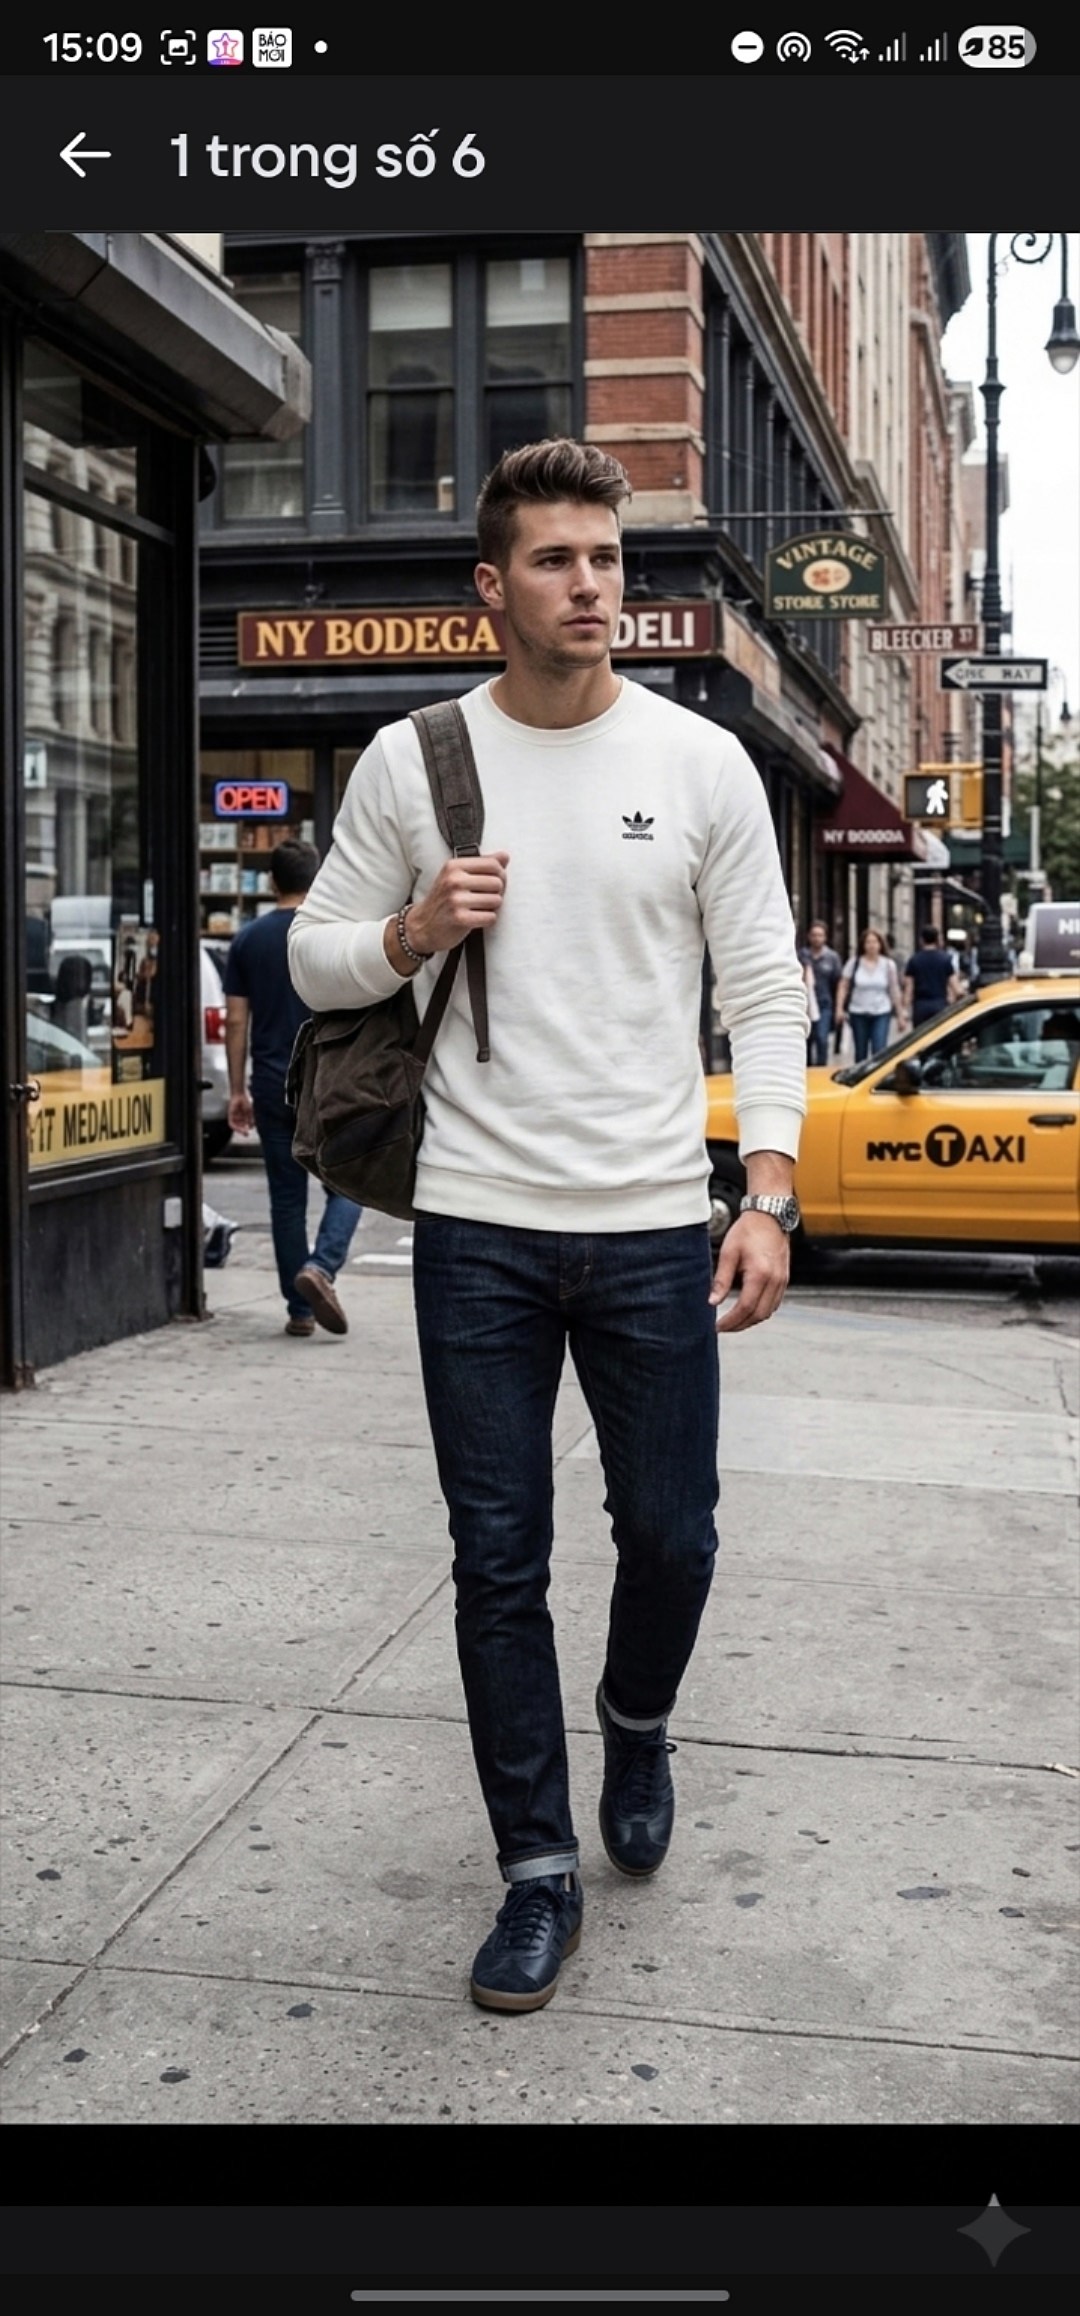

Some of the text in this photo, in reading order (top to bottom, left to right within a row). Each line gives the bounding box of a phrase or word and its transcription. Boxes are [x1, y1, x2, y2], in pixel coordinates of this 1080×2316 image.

[776, 538, 878, 571] VINTAGE
[256, 611, 694, 657] NY BODEGA DELI
[871, 628, 953, 651] BLEECKER
[219, 786, 282, 811] OPEN
[63, 1093, 152, 1148] MEDALLION
[867, 1129, 1025, 1165] NYC TAXI
